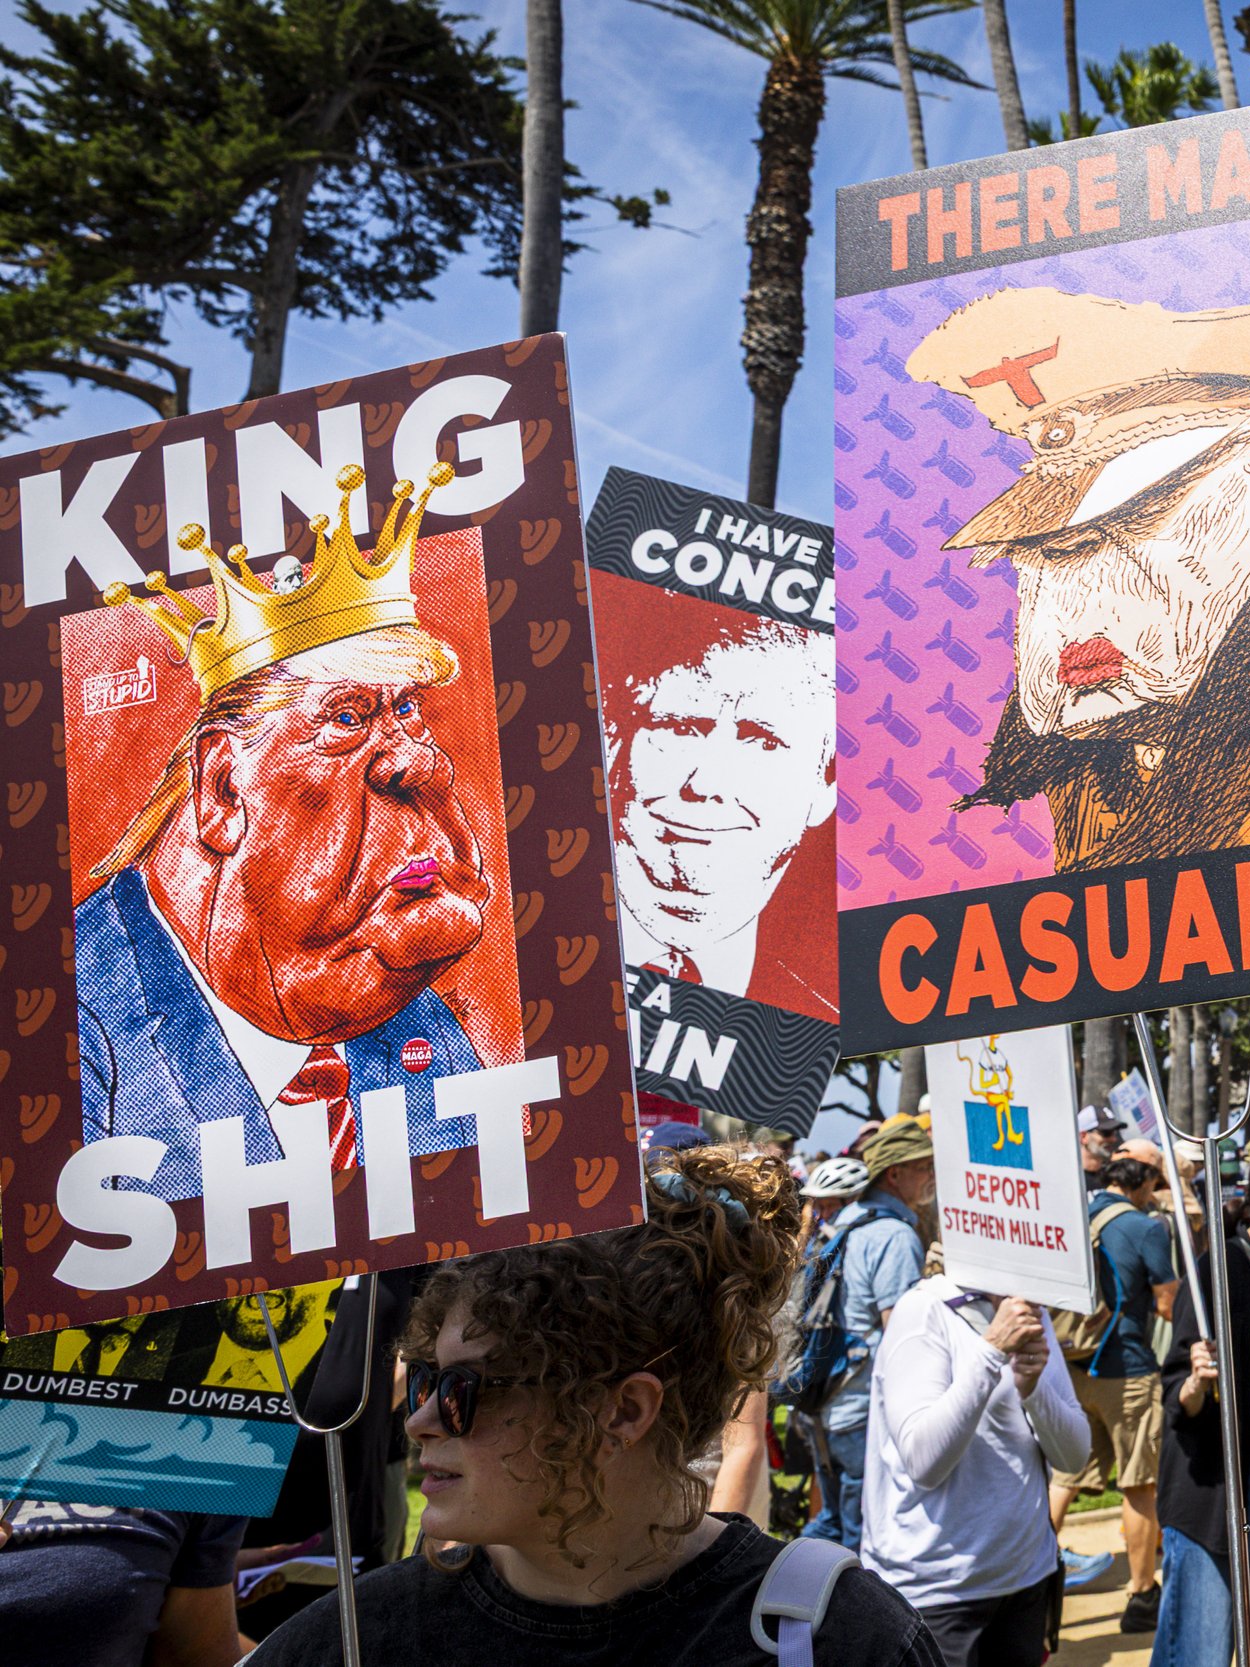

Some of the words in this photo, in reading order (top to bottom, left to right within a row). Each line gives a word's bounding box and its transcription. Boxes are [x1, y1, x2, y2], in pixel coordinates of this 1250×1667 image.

[879, 154, 1122, 272] THERE
[19, 375, 526, 608] KING
[694, 508, 712, 534] I
[716, 514, 823, 566] HAVE
[88, 680, 152, 709] STUPID
[641, 982, 671, 1014] A
[402, 1051, 432, 1061] MAGA
[52, 1056, 561, 1290] SHIT
[965, 1171, 1041, 1210] DEPORT
[943, 1207, 1005, 1241] STEPHEN
[1009, 1221, 1068, 1252] MILLER
[3, 1373, 138, 1400] DUMBEST
[168, 1387, 293, 1415] DUMBASS
